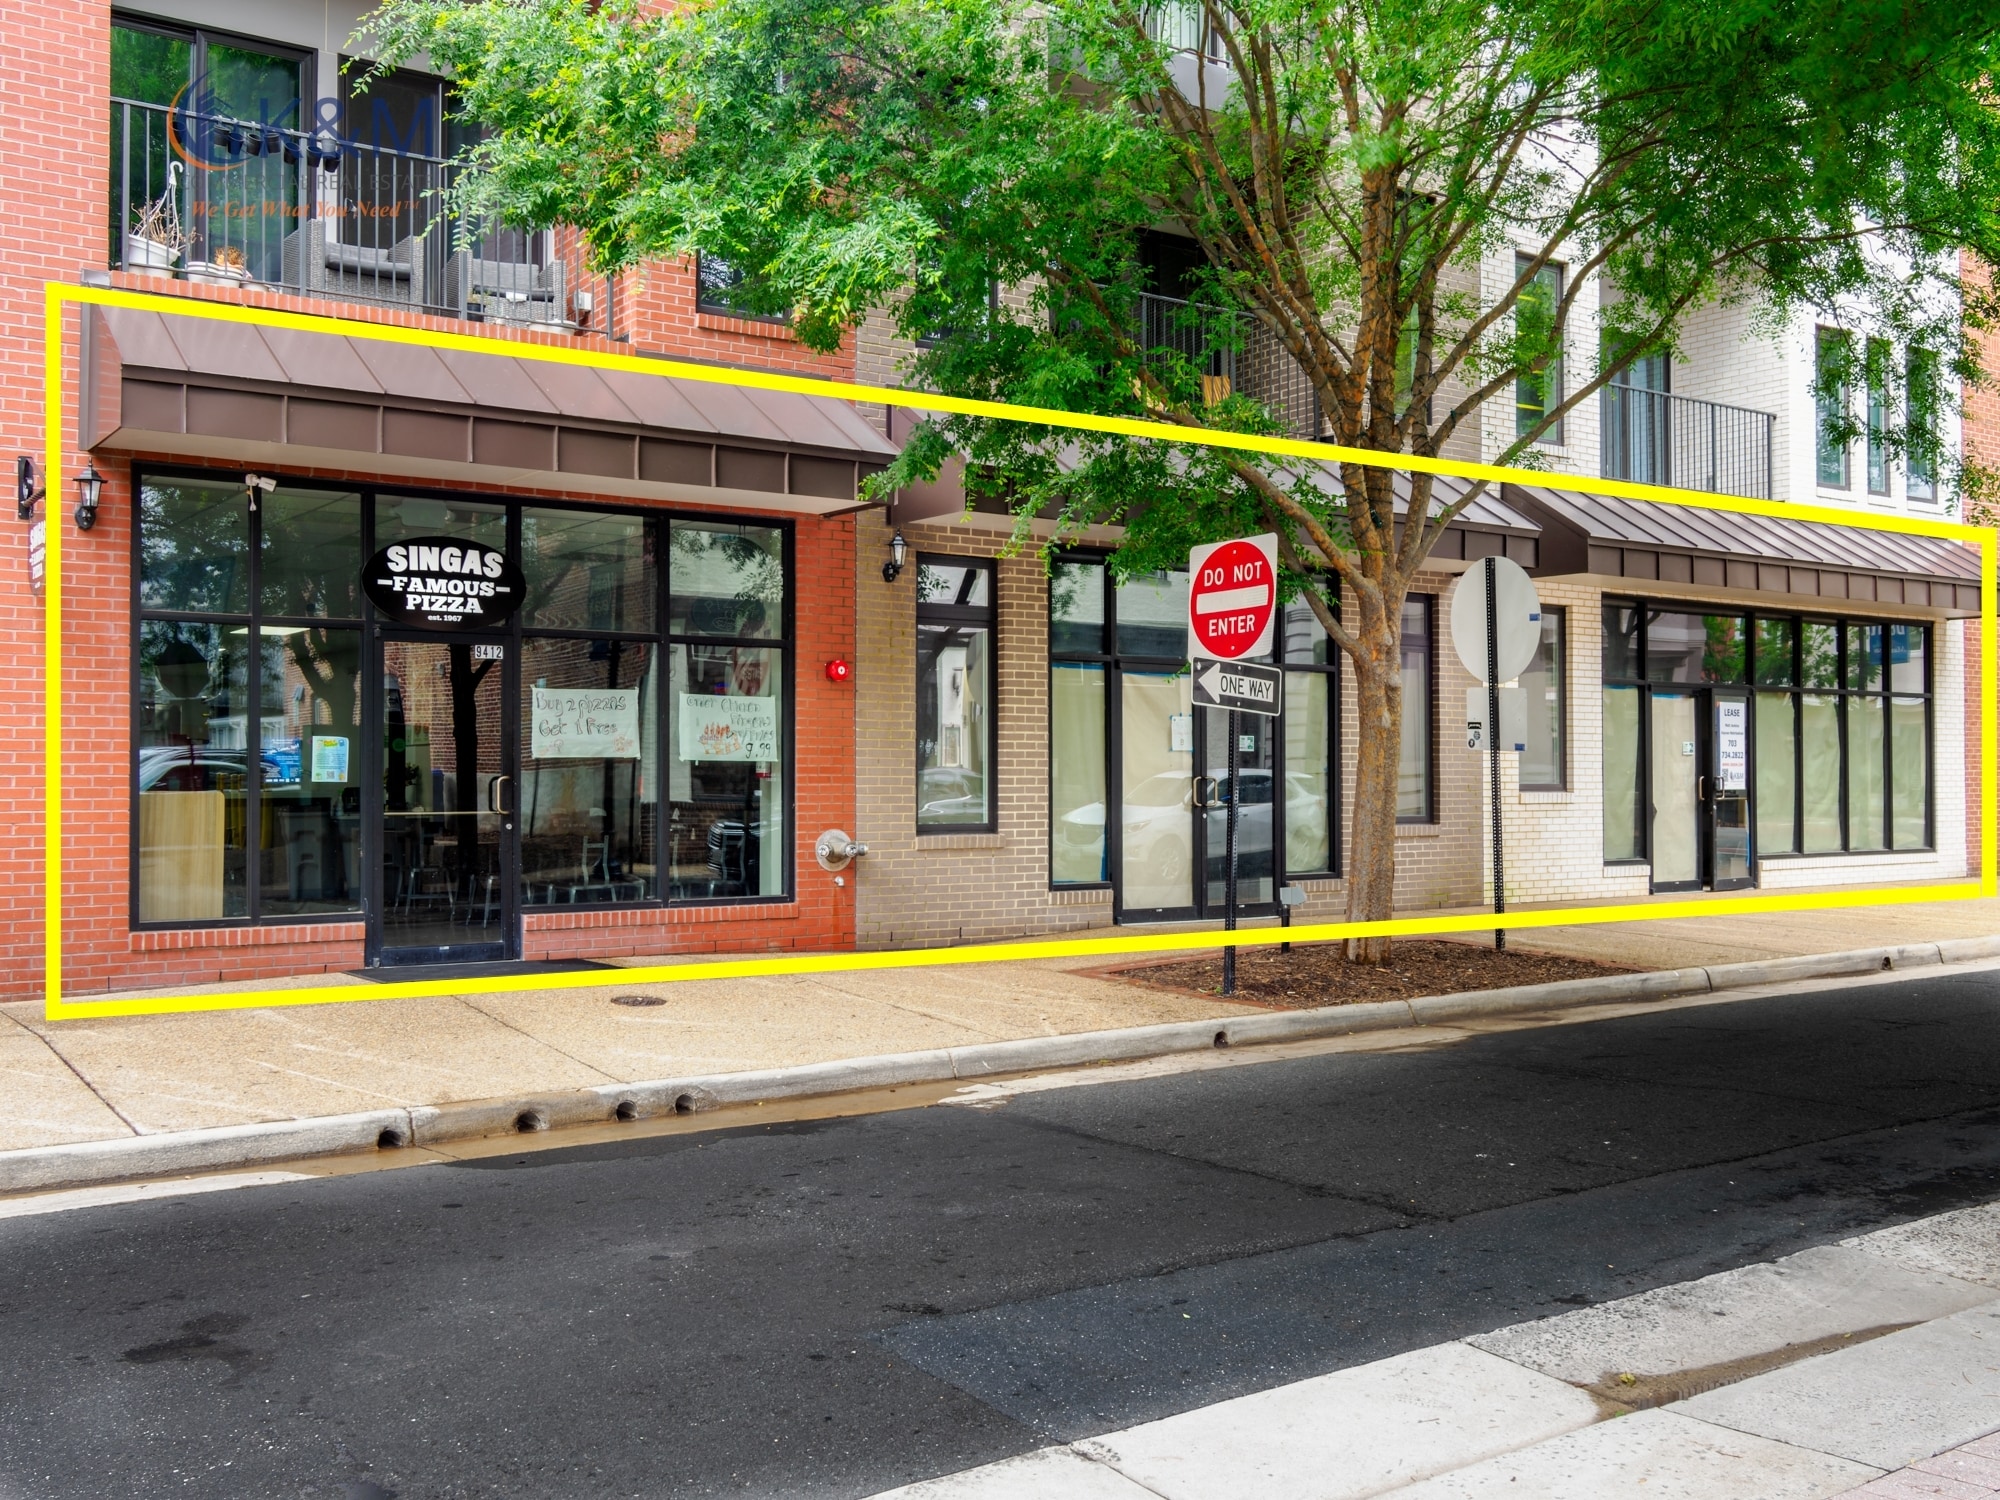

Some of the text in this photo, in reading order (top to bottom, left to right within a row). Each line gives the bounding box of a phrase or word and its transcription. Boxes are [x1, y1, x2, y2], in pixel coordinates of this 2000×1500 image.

[387, 545, 503, 578] SINGAS
[1204, 561, 1262, 587] DO NOT
[406, 594, 483, 613] PIZZA
[1208, 614, 1255, 637] ENTER
[476, 646, 502, 658] 9412
[1220, 675, 1272, 699] ONE WAY
[536, 691, 563, 717] Buy
[566, 698, 577, 711] 2
[1724, 708, 1741, 717] LEASE
[539, 718, 567, 737] Get
